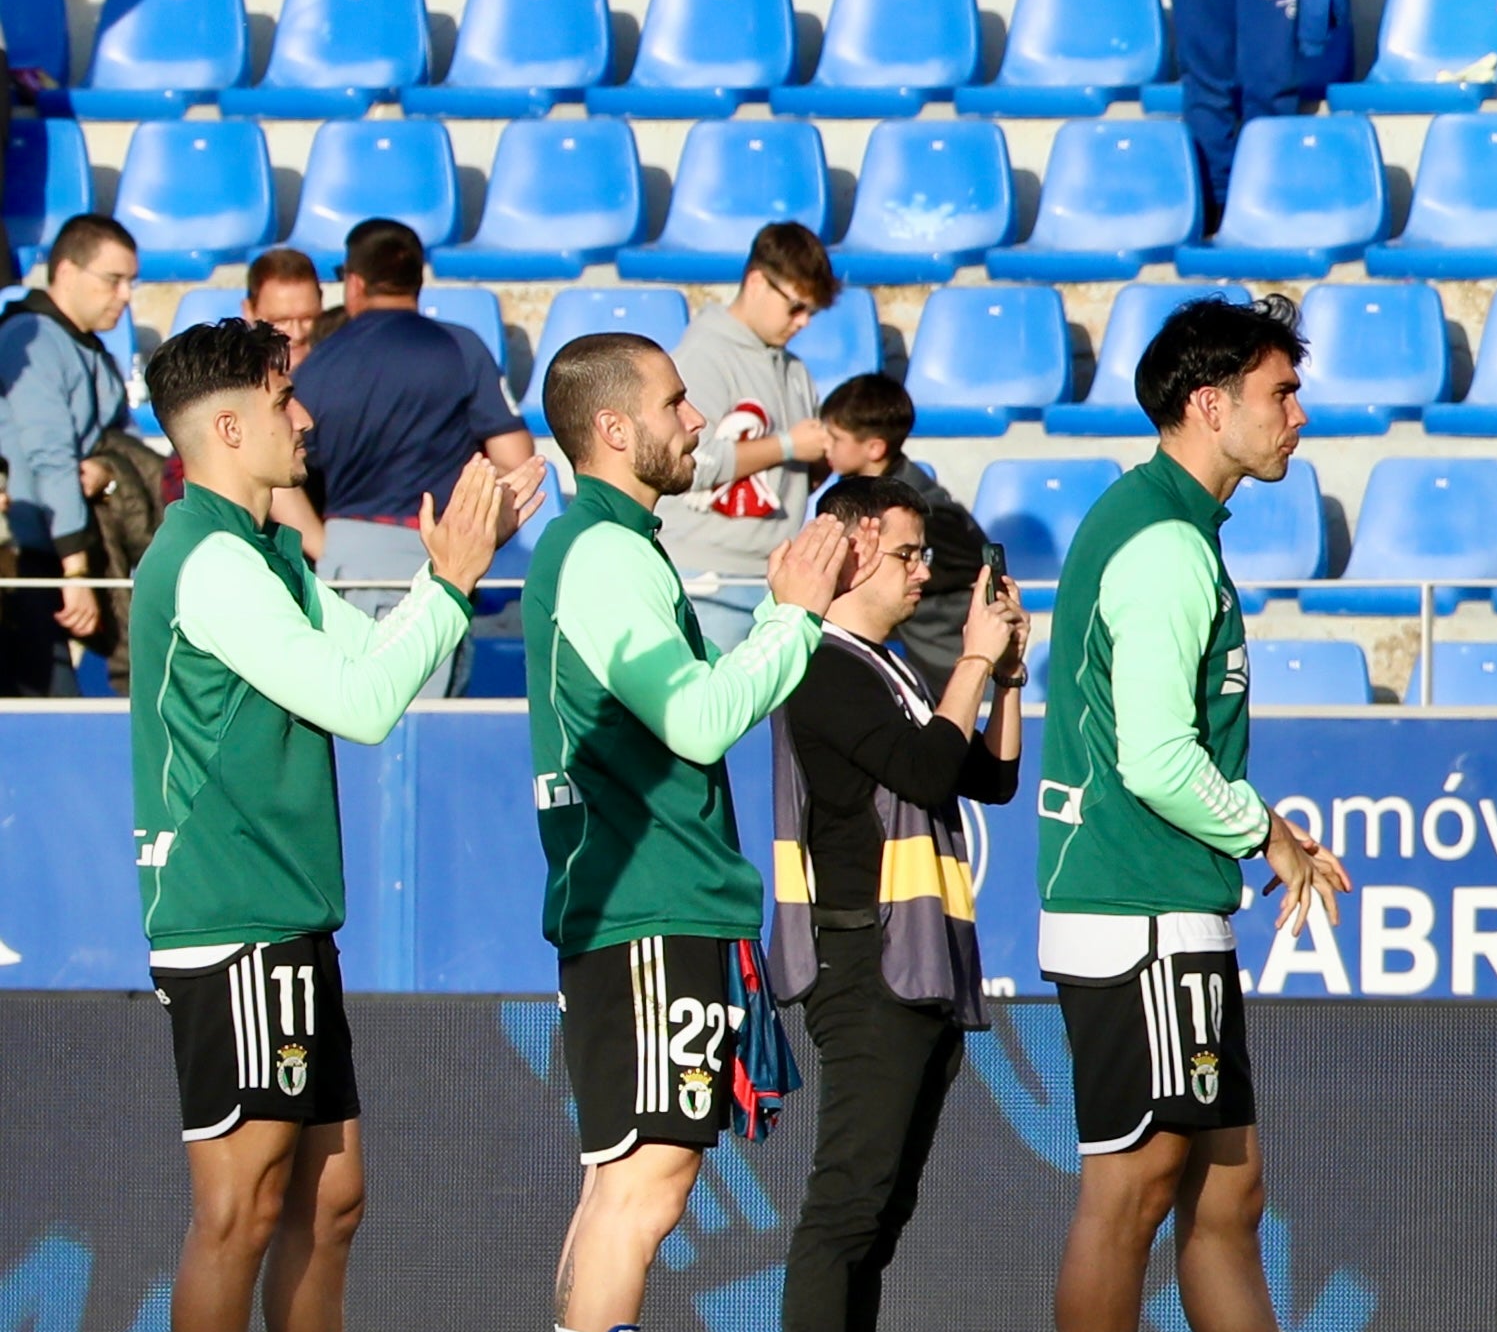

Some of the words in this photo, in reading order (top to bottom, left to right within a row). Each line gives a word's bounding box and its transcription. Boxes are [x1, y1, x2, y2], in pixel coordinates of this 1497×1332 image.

[270, 965, 316, 1037] 11
[668, 997, 727, 1073] 22
[1179, 972, 1223, 1045] 10
